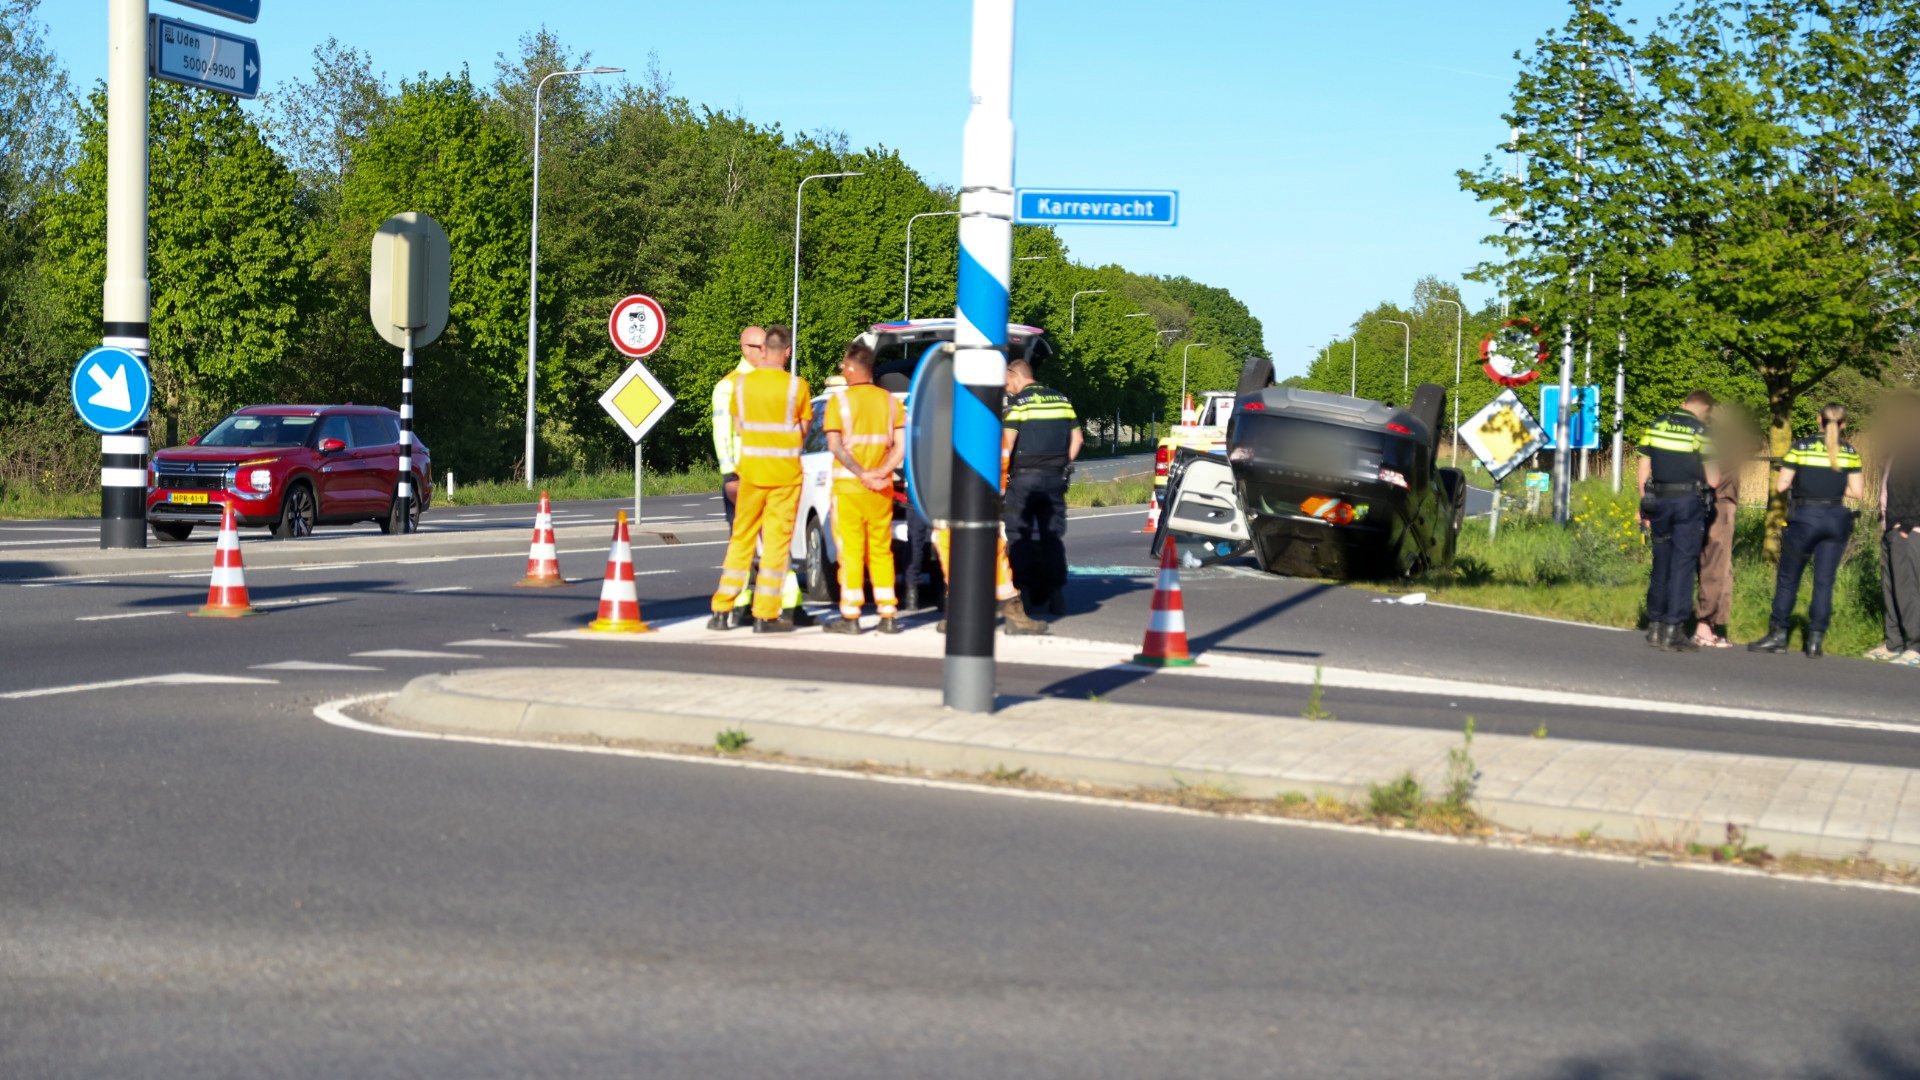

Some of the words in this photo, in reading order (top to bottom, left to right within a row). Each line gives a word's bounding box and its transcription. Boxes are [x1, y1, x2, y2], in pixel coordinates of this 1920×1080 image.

[177, 31, 200, 49] Uden
[183, 55, 236, 80] 5000-9900
[1038, 198, 1154, 217] Karrevracht
